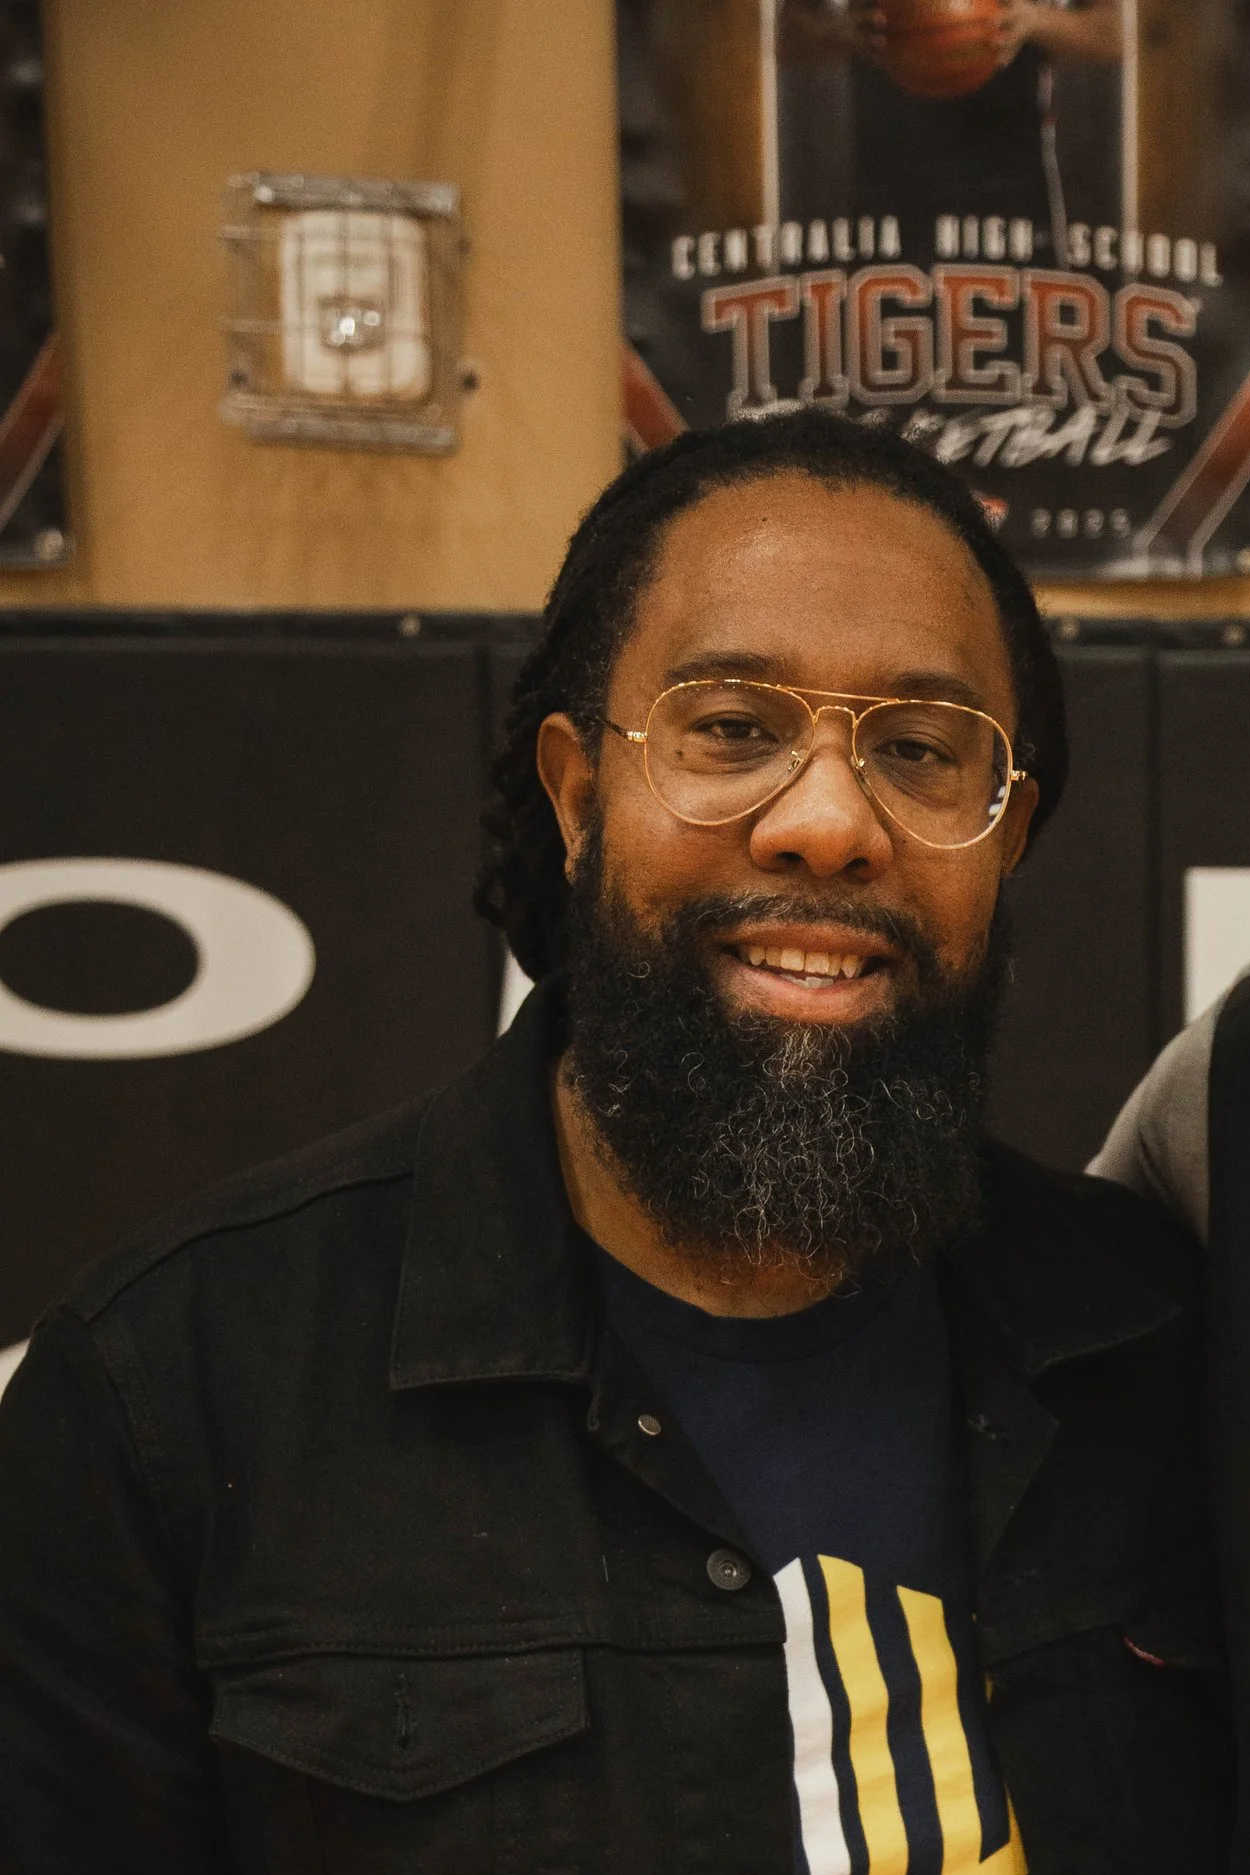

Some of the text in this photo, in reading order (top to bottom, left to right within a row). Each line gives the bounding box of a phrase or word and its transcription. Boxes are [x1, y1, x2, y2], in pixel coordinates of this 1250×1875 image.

[671, 213, 1223, 288] CENTRALIA HIGH SCHOOL
[702, 262, 1199, 429] TIGERS
